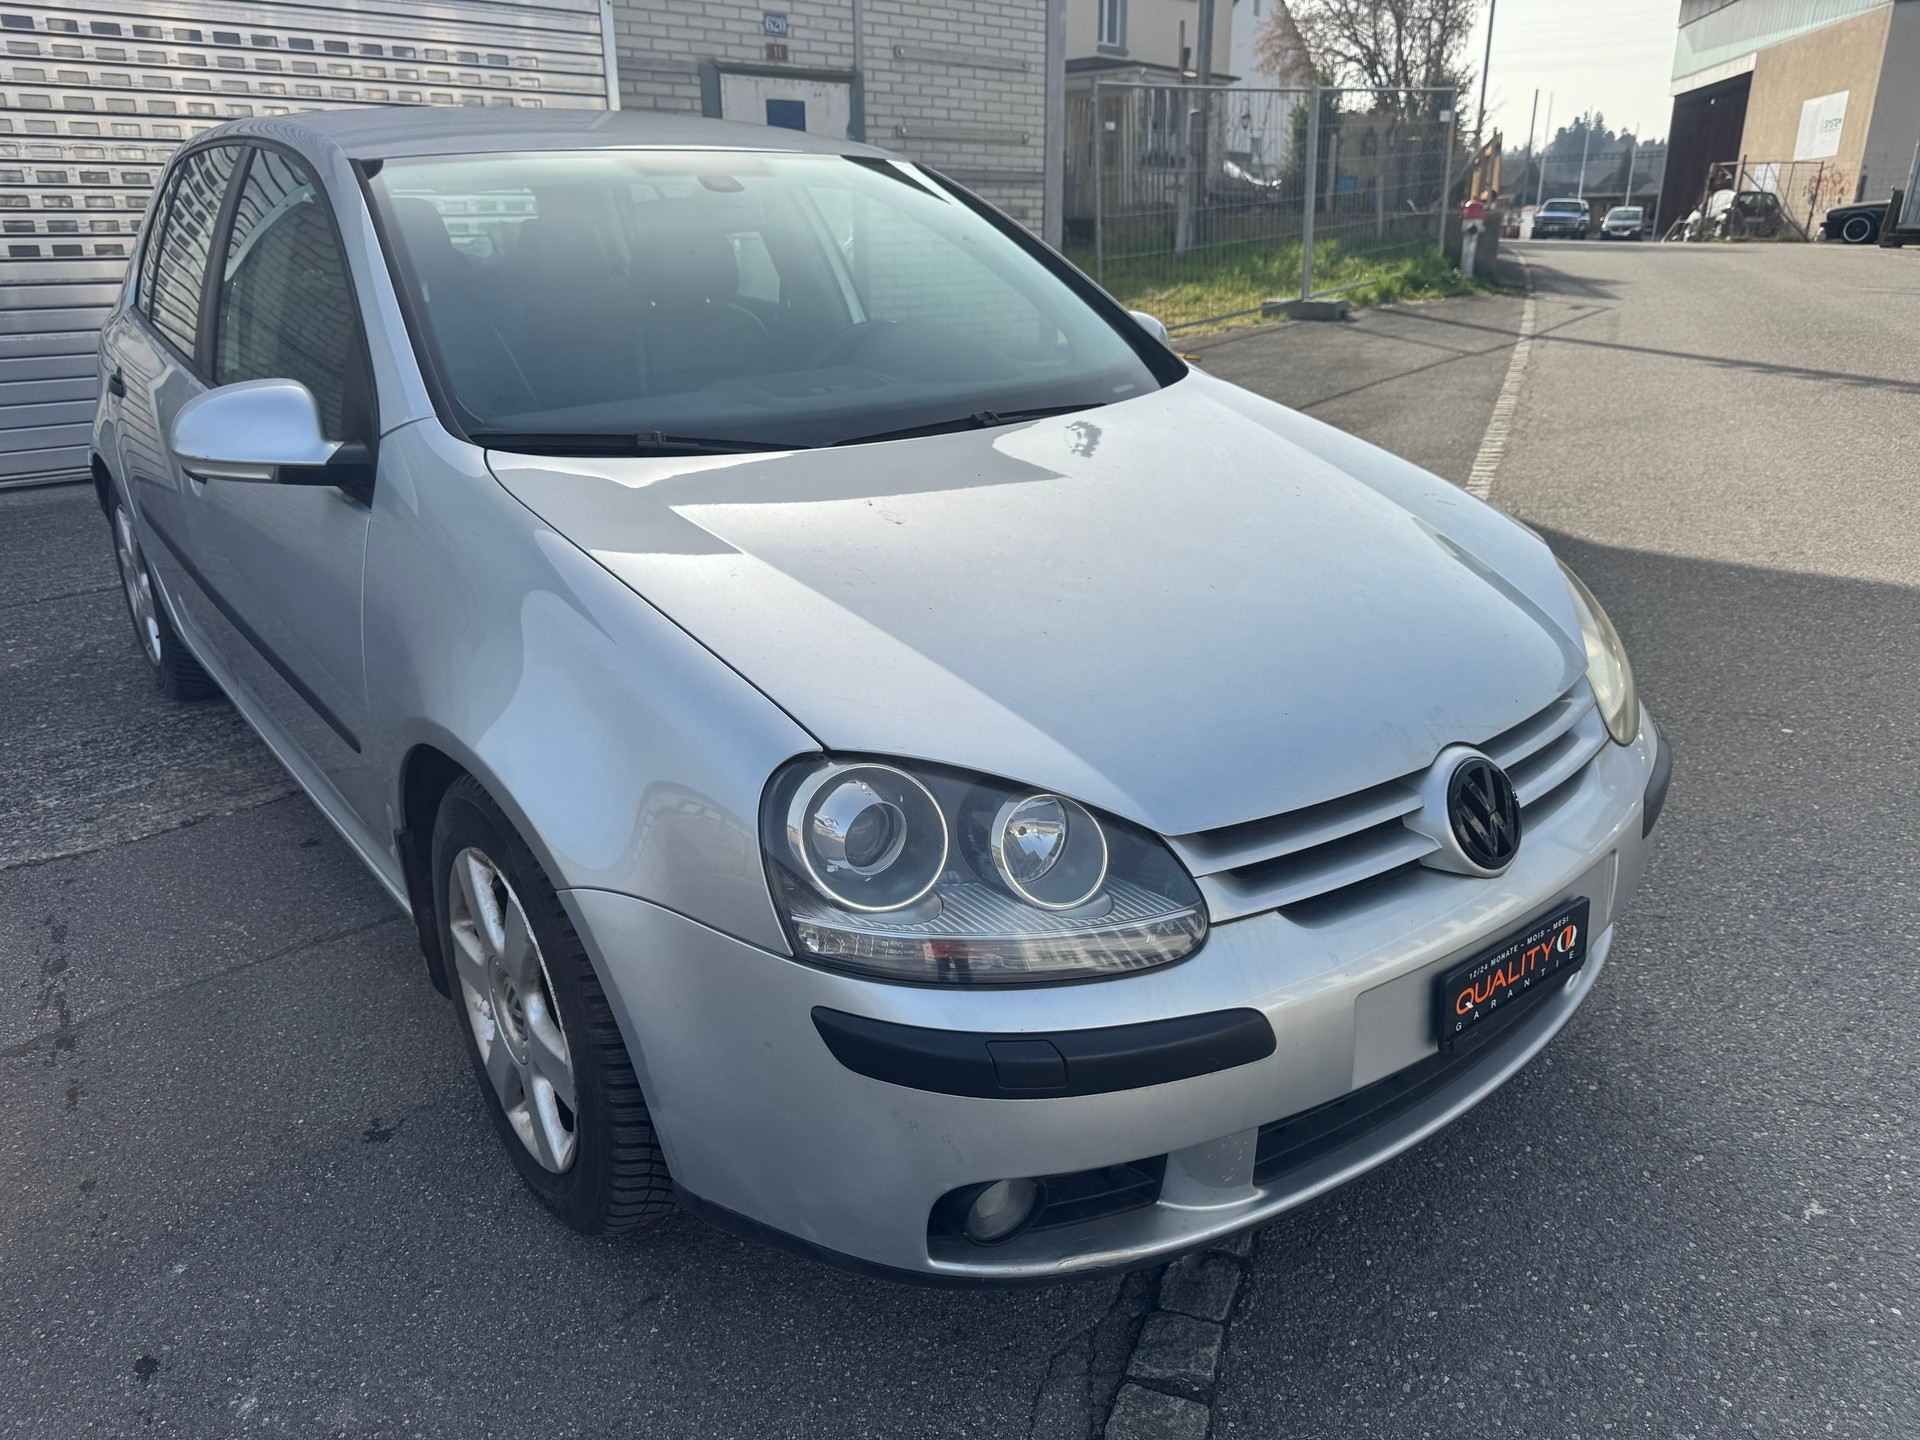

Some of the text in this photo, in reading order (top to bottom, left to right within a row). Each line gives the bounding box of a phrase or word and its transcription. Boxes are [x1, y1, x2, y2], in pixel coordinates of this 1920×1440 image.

[765, 16, 787, 32] 620
[1456, 936, 1556, 1015] QUALITY
[1469, 964, 1488, 980] 12/24
[1490, 945, 1518, 966] MONATE
[1526, 930, 1545, 944] MOIS
[1553, 916, 1569, 930] MESI
[1455, 951, 1575, 1031] GARANTIE
